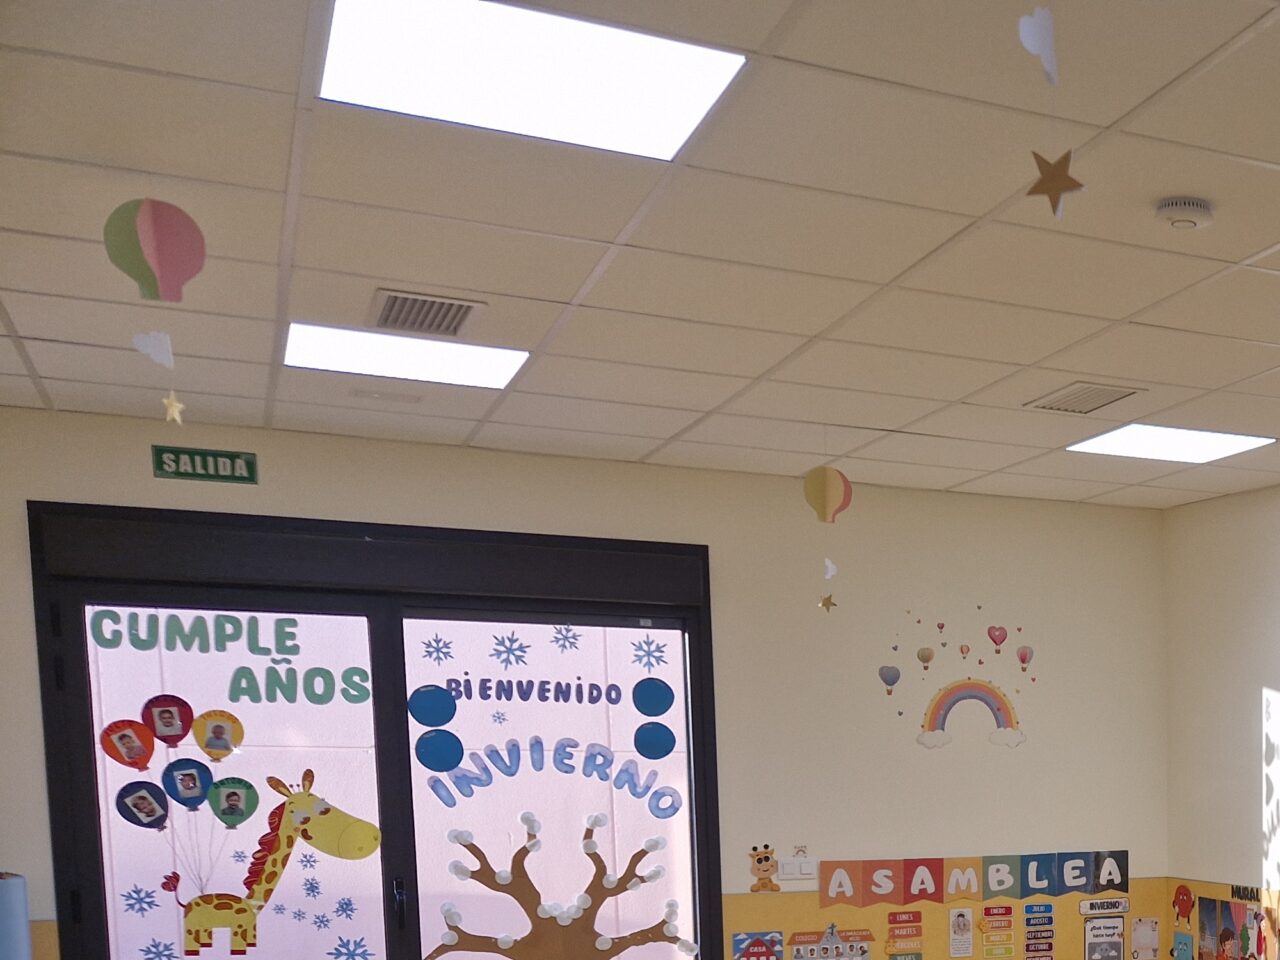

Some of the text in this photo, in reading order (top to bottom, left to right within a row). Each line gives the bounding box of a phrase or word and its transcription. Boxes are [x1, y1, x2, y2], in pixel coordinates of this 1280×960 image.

[162, 452, 249, 478] SALIDA
[90, 609, 301, 656] CUMPLE
[228, 657, 371, 705] AÑOS
[427, 735, 682, 820] INVIERNO
[827, 857, 1122, 899] ASAMBLEA
[1231, 885, 1261, 902] MURAL
[1089, 900, 1120, 911] INVIERNO
[894, 928, 917, 936] MARTES
